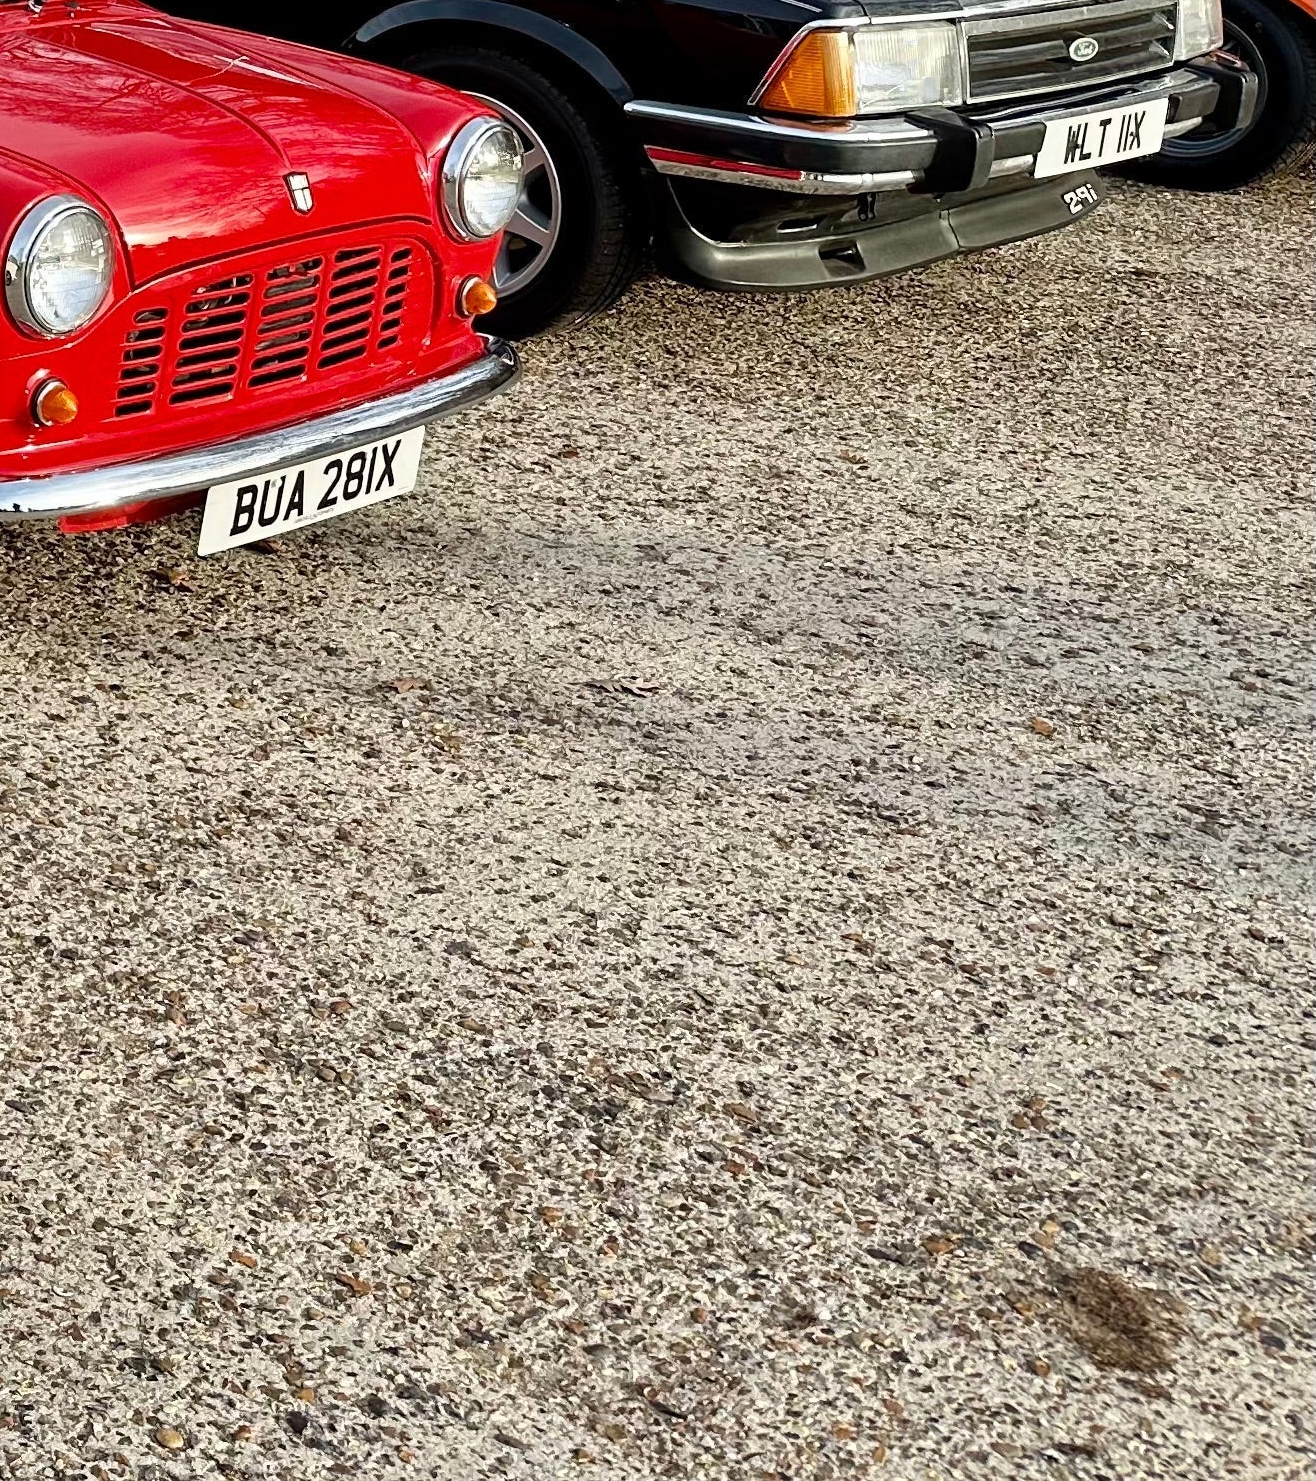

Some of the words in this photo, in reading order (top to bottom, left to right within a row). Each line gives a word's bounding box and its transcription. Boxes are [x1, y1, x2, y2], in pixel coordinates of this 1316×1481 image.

[1064, 118, 1112, 164] WLT
[1063, 183, 1098, 215] 29i
[229, 470, 305, 537] BUA
[317, 439, 402, 511] 281X
